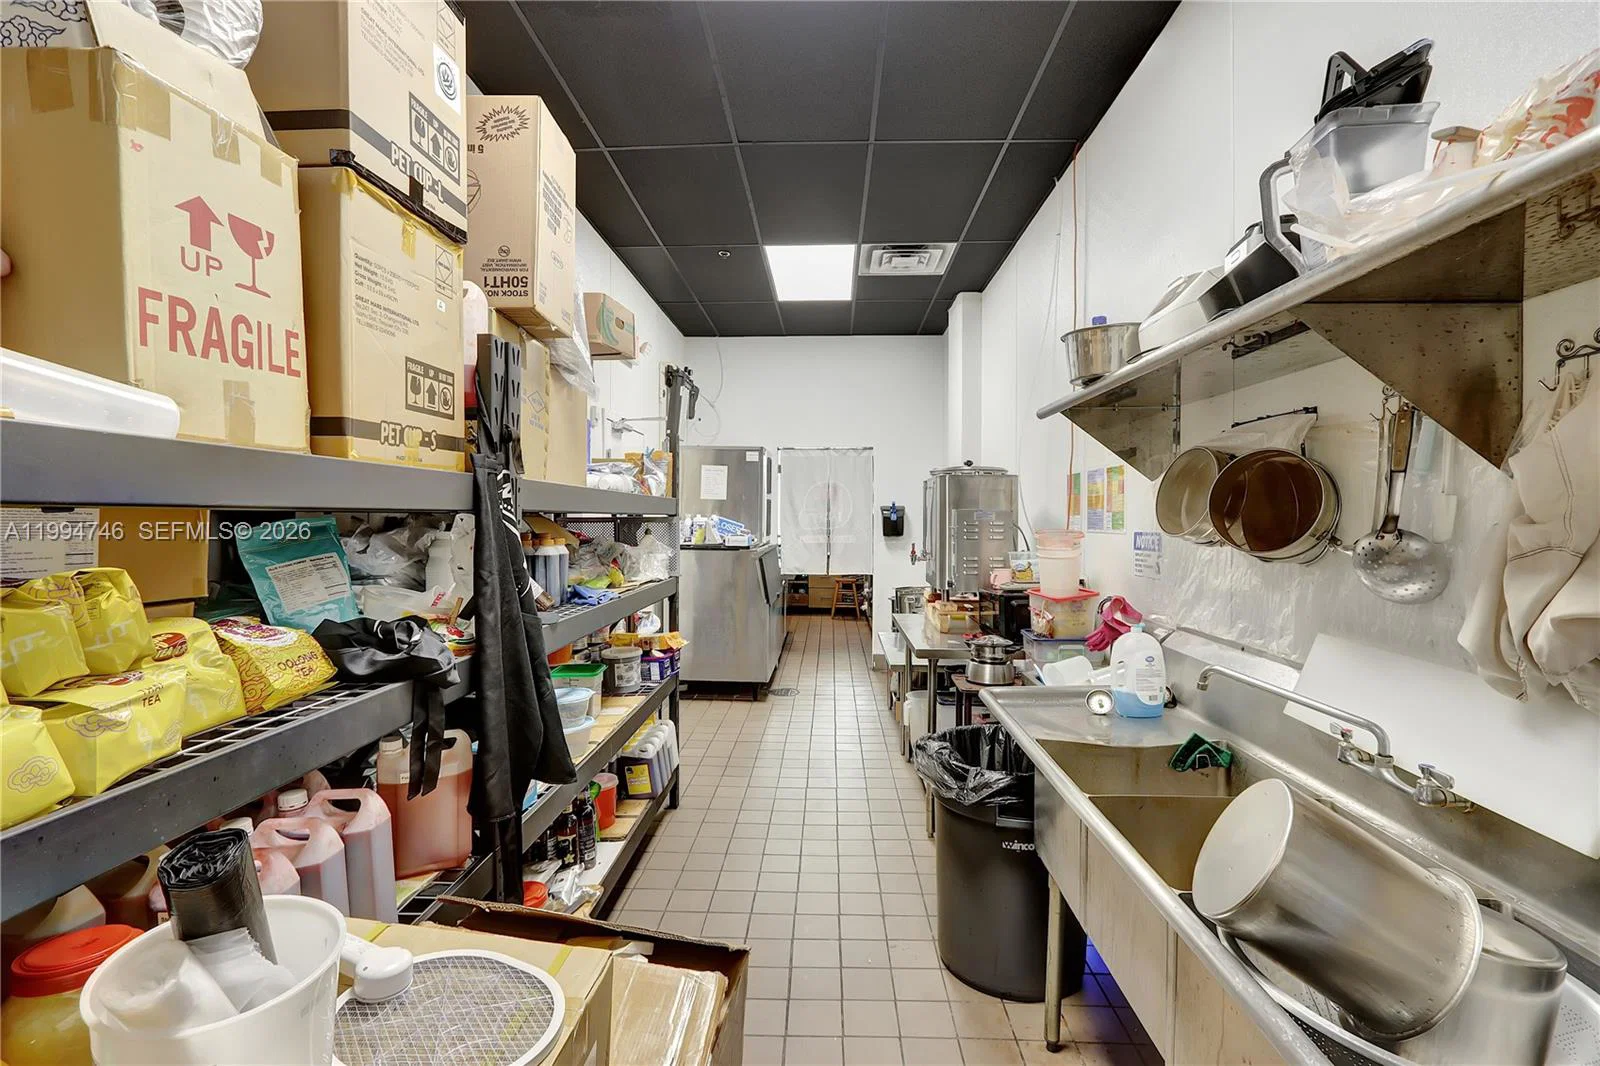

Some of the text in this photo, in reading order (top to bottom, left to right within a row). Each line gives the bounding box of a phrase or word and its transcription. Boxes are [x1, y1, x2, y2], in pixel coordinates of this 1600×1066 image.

[410, 97, 428, 120] FRAGILE
[390, 141, 412, 177] PET
[478, 144, 484, 153] 5
[180, 245, 223, 277] UP
[484, 276, 529, 288] 50HT1
[138, 286, 301, 378] FRAGILE
[406, 361, 424, 375] FRAGILE
[380, 420, 402, 446] PET
[1135, 534, 1161, 551] NOTICE
[277, 651, 318, 672] OOLONG
[142, 694, 161, 708] TEA
